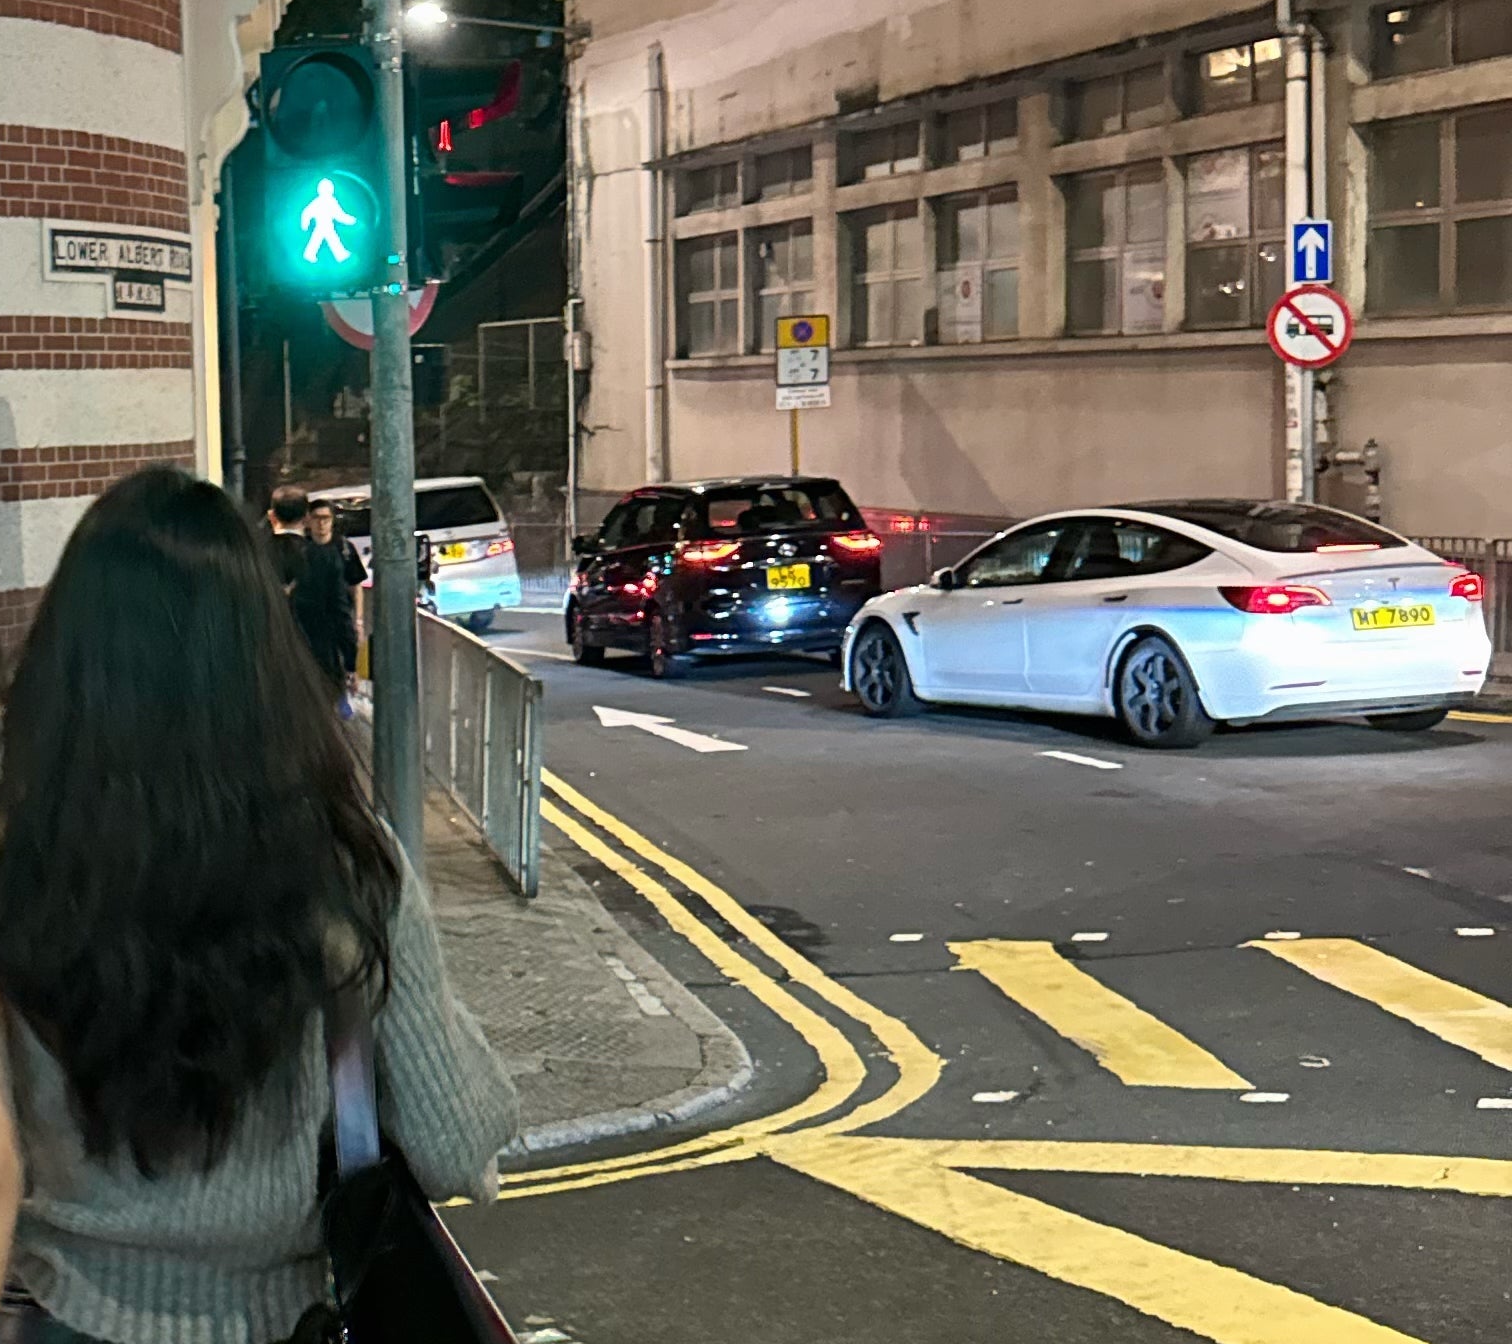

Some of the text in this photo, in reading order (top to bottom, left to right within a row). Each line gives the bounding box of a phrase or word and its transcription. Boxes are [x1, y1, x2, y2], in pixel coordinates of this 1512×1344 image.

[55, 240, 108, 261] LOWER
[118, 243, 165, 267] ALBERT
[1387, 606, 1431, 624] 7890
